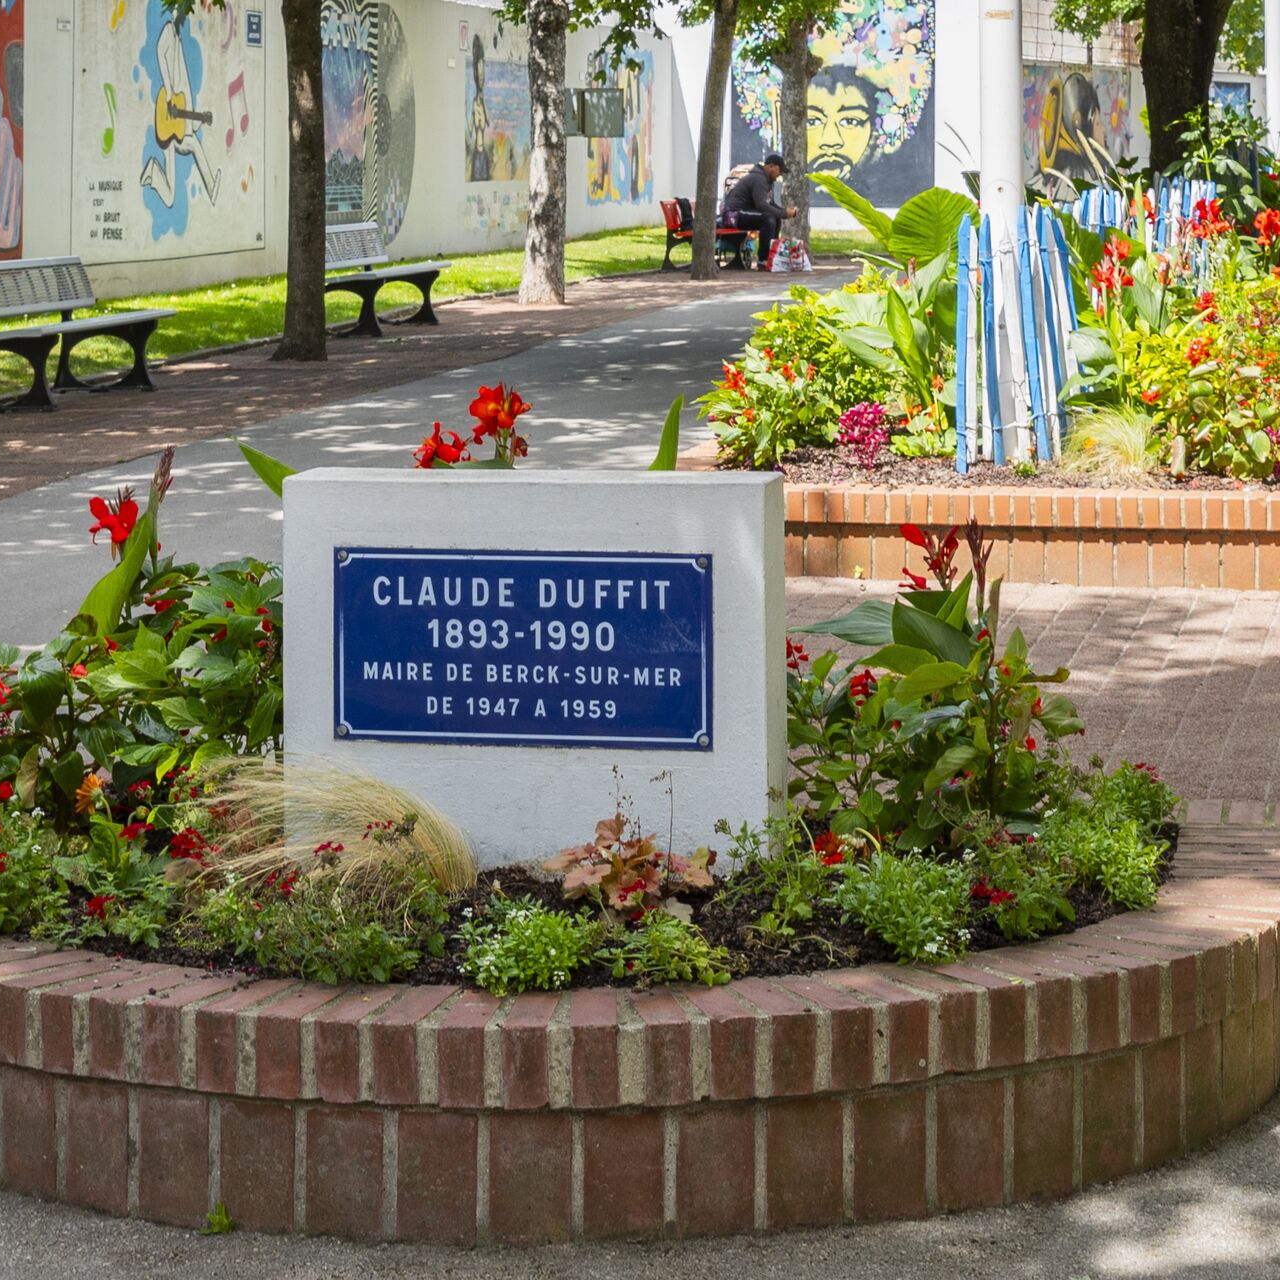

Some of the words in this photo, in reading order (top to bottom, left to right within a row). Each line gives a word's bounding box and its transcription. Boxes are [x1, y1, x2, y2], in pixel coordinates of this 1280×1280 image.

[98, 180, 123, 192] MUSIQUE
[103, 212, 120, 222] BRUIT
[102, 227, 123, 240] PENSE
[372, 575, 515, 607] CLAUDE
[538, 578, 671, 610] DUFFIT
[426, 618, 616, 652] 1893-1990
[363, 661, 433, 682] MAIRE
[446, 663, 473, 683] DE
[486, 664, 681, 687] BERCK-SUR-MER
[426, 696, 453, 715] DE
[466, 697, 520, 717] 1947
[534, 698, 547, 717] A
[560, 699, 617, 719] 1959
